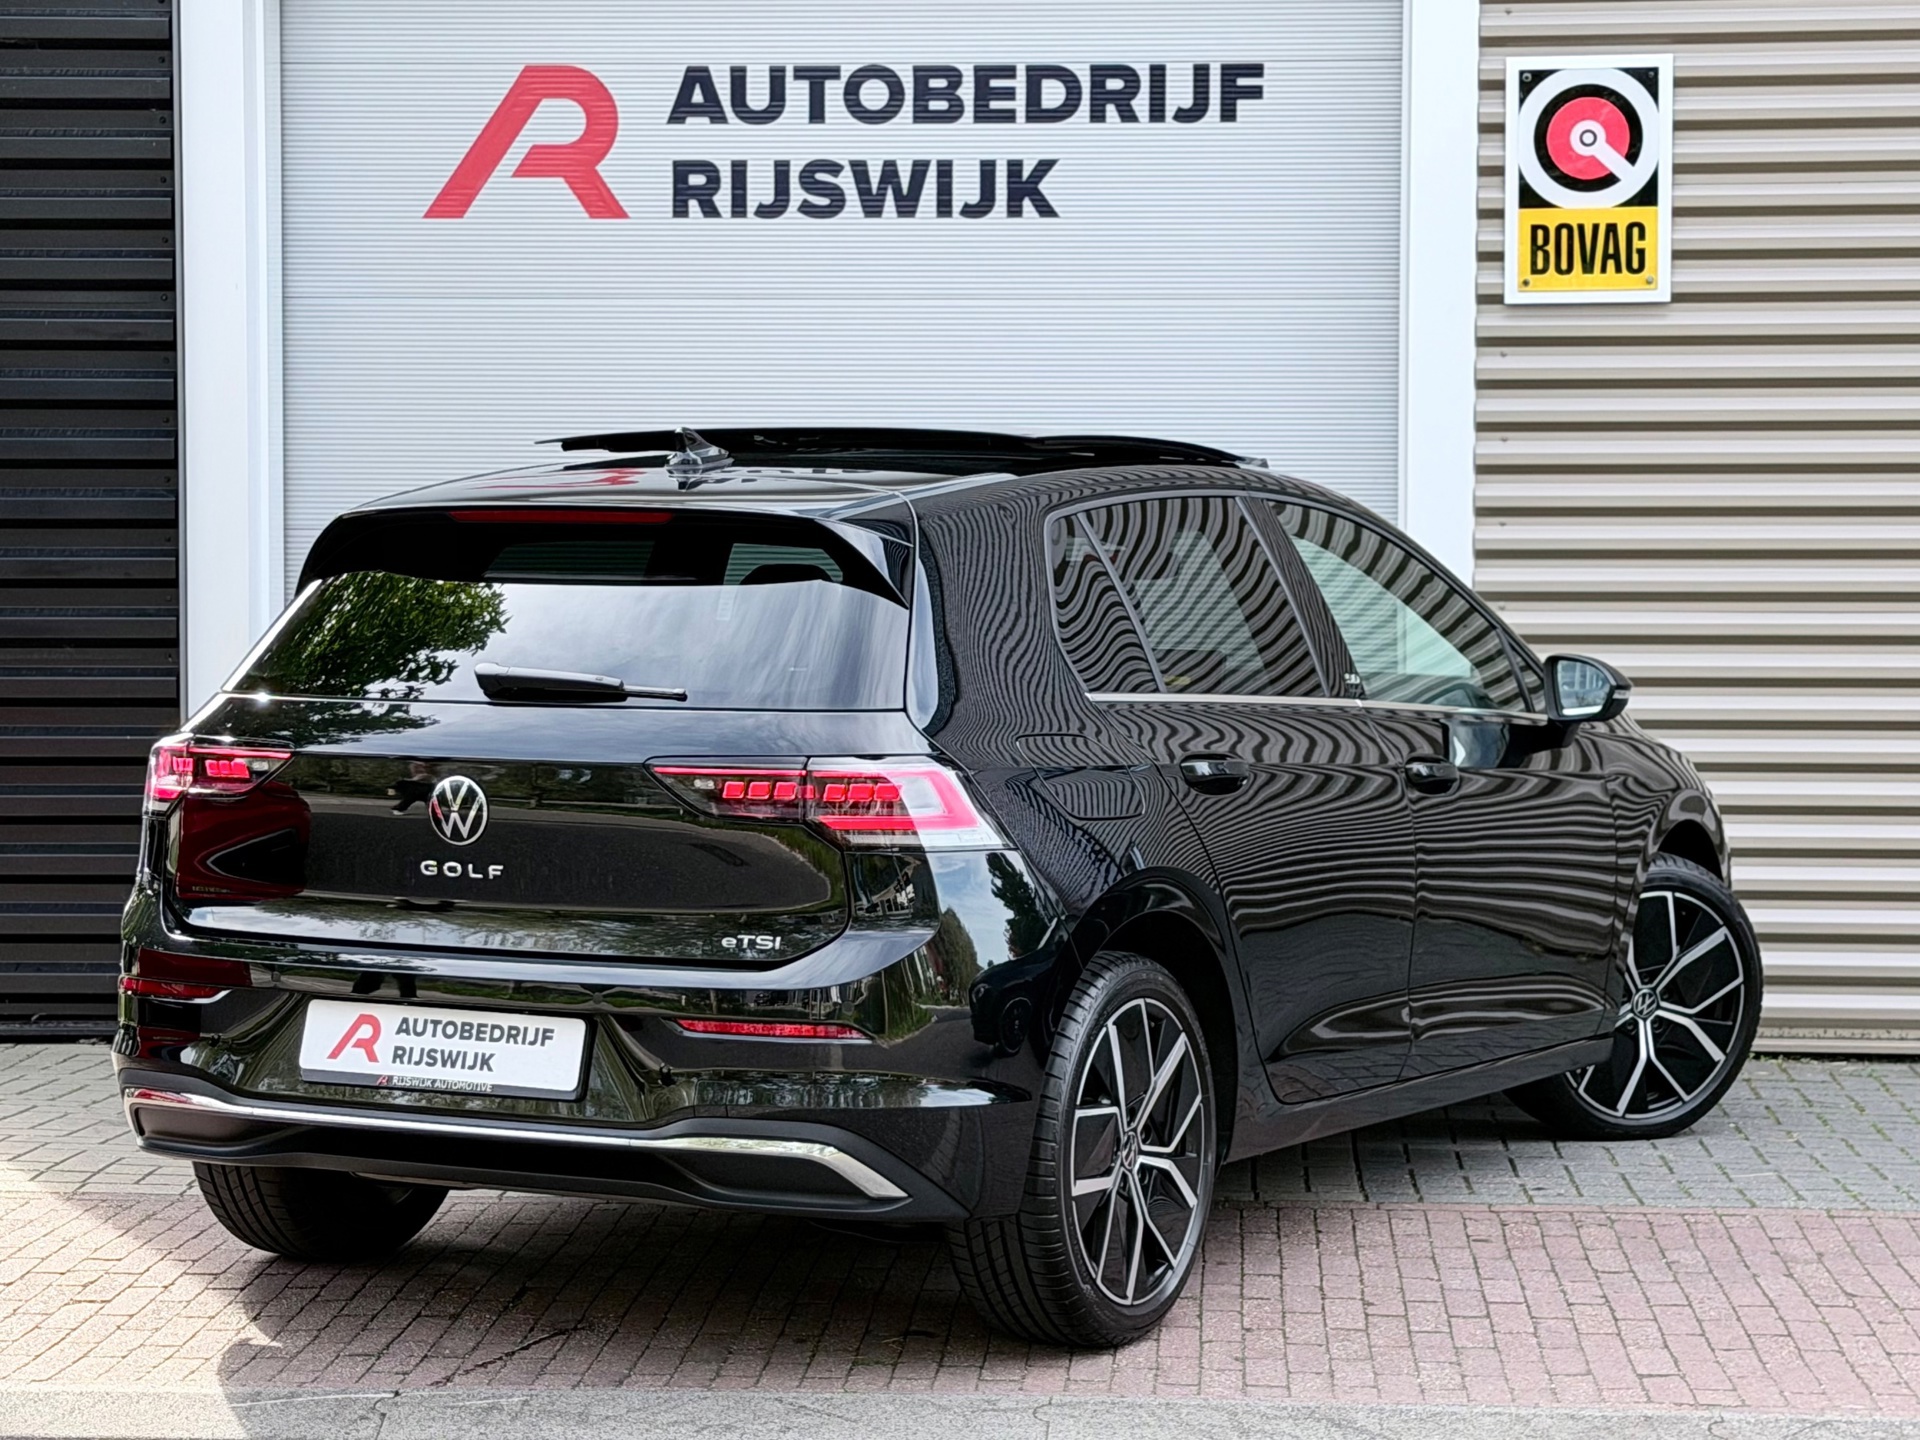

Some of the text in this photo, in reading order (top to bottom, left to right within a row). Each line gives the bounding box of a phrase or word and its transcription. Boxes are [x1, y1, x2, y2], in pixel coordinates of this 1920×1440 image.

[667, 63, 1264, 124] AUTOBEDRIJF
[672, 158, 1060, 219] RIJSWIJK
[1530, 222, 1646, 275] BOVAG
[420, 860, 504, 880] GOLF
[721, 934, 782, 951] eTSI
[395, 1017, 555, 1047] AUTOBEDRIJF
[391, 1046, 496, 1072] RIJSWIJK
[392, 1076, 433, 1088] RIJSWIJK
[434, 1079, 493, 1093] AUTOMOTIVE
